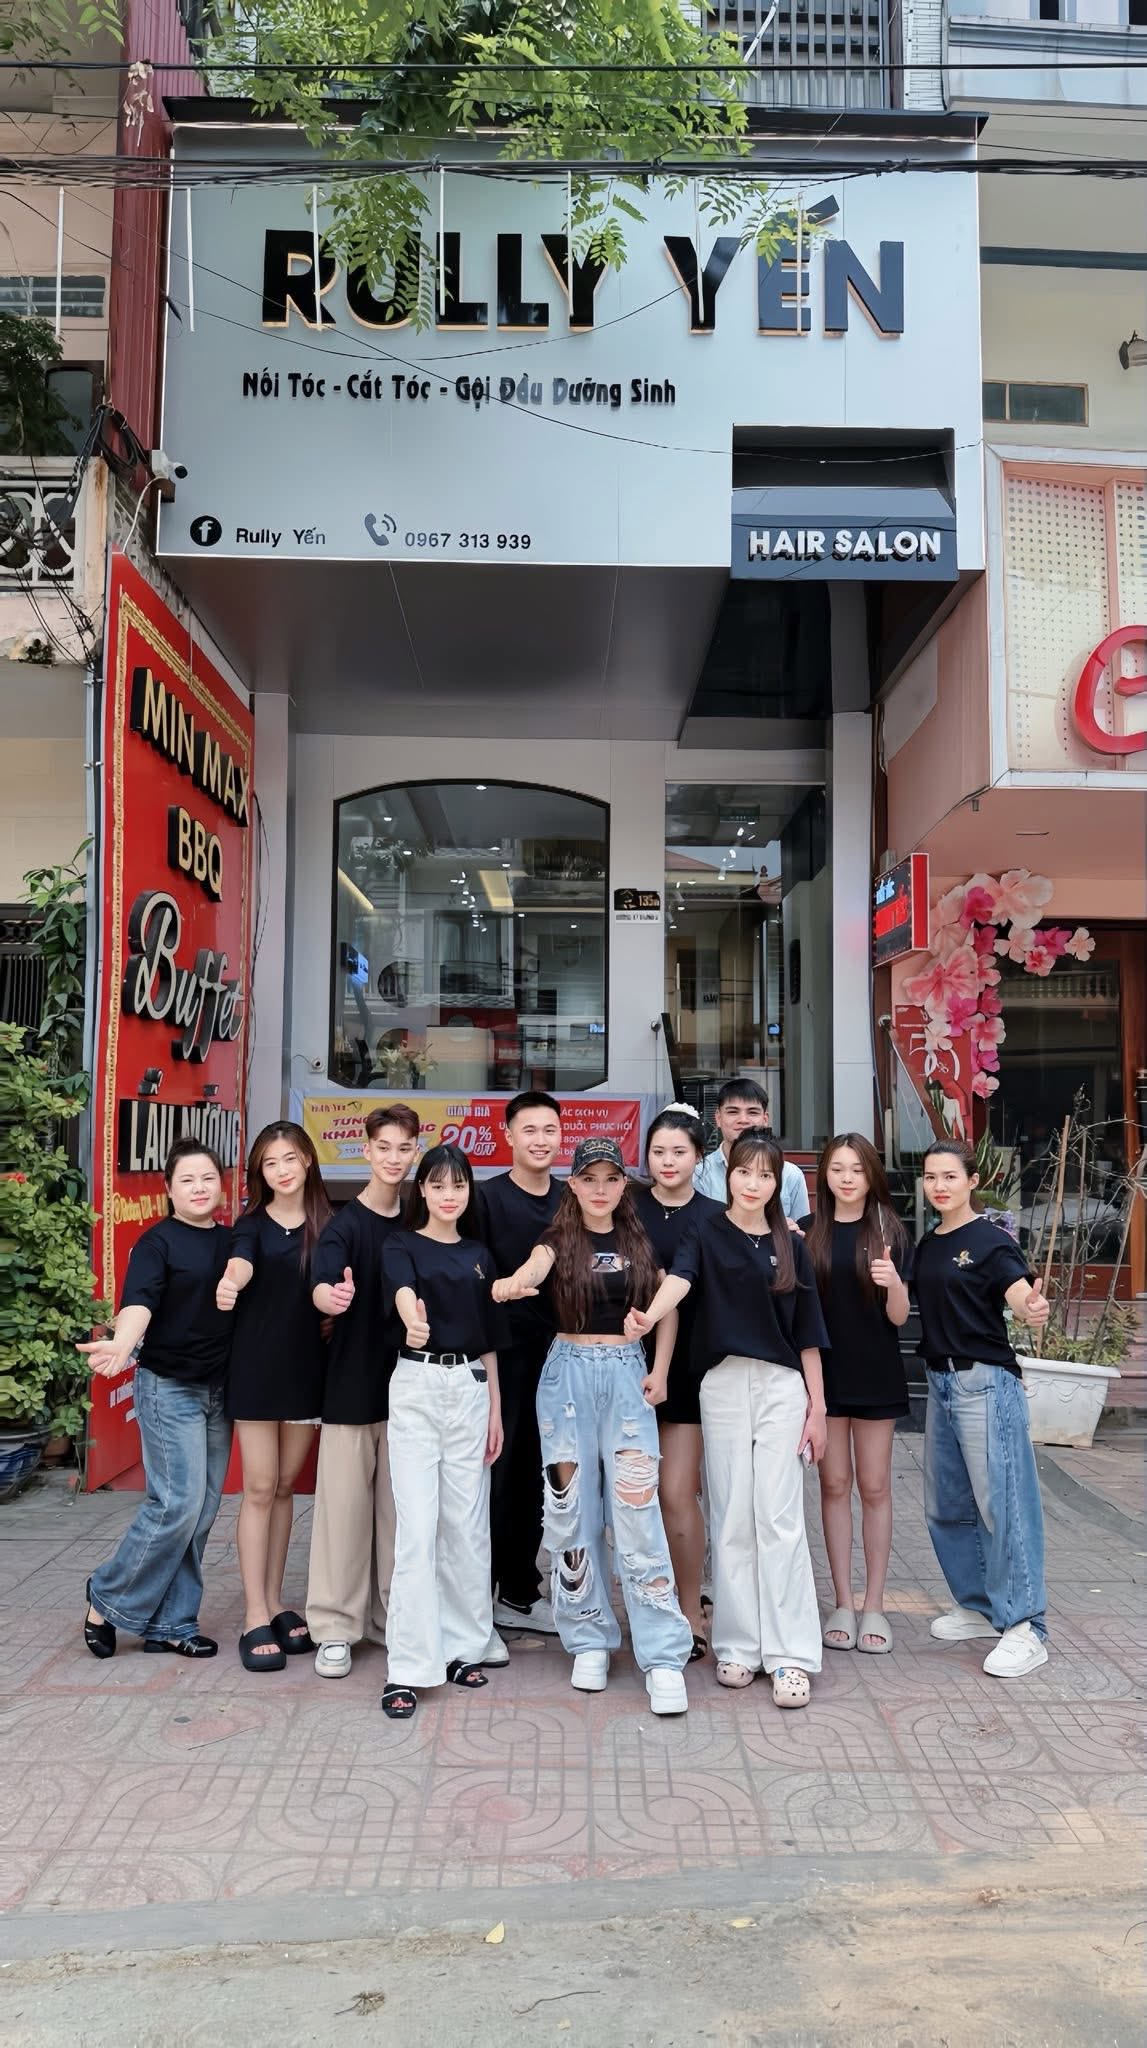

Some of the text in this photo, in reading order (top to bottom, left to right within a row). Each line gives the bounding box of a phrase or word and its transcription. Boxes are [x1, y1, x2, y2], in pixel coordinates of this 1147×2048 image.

[262, 194, 905, 338] RULLY YẾN
[242, 367, 280, 398] Nối
[288, 372, 326, 398] Tóc
[347, 370, 383, 400] Cắt
[392, 374, 431, 400] Tóc
[455, 375, 491, 410] Gội
[630, 377, 676, 403] Sinh
[235, 526, 326, 547] Rully Yến
[404, 531, 531, 549] 0967 313 939
[749, 529, 942, 559] HAIR SALON
[138, 668, 250, 828] MIN MAX
[174, 807, 223, 902] BBQ
[129, 890, 246, 1063] Buffet
[322, 1129, 363, 1140] KHAI
[442, 1125, 492, 1154] 20%
[473, 1142, 497, 1156] OFF
